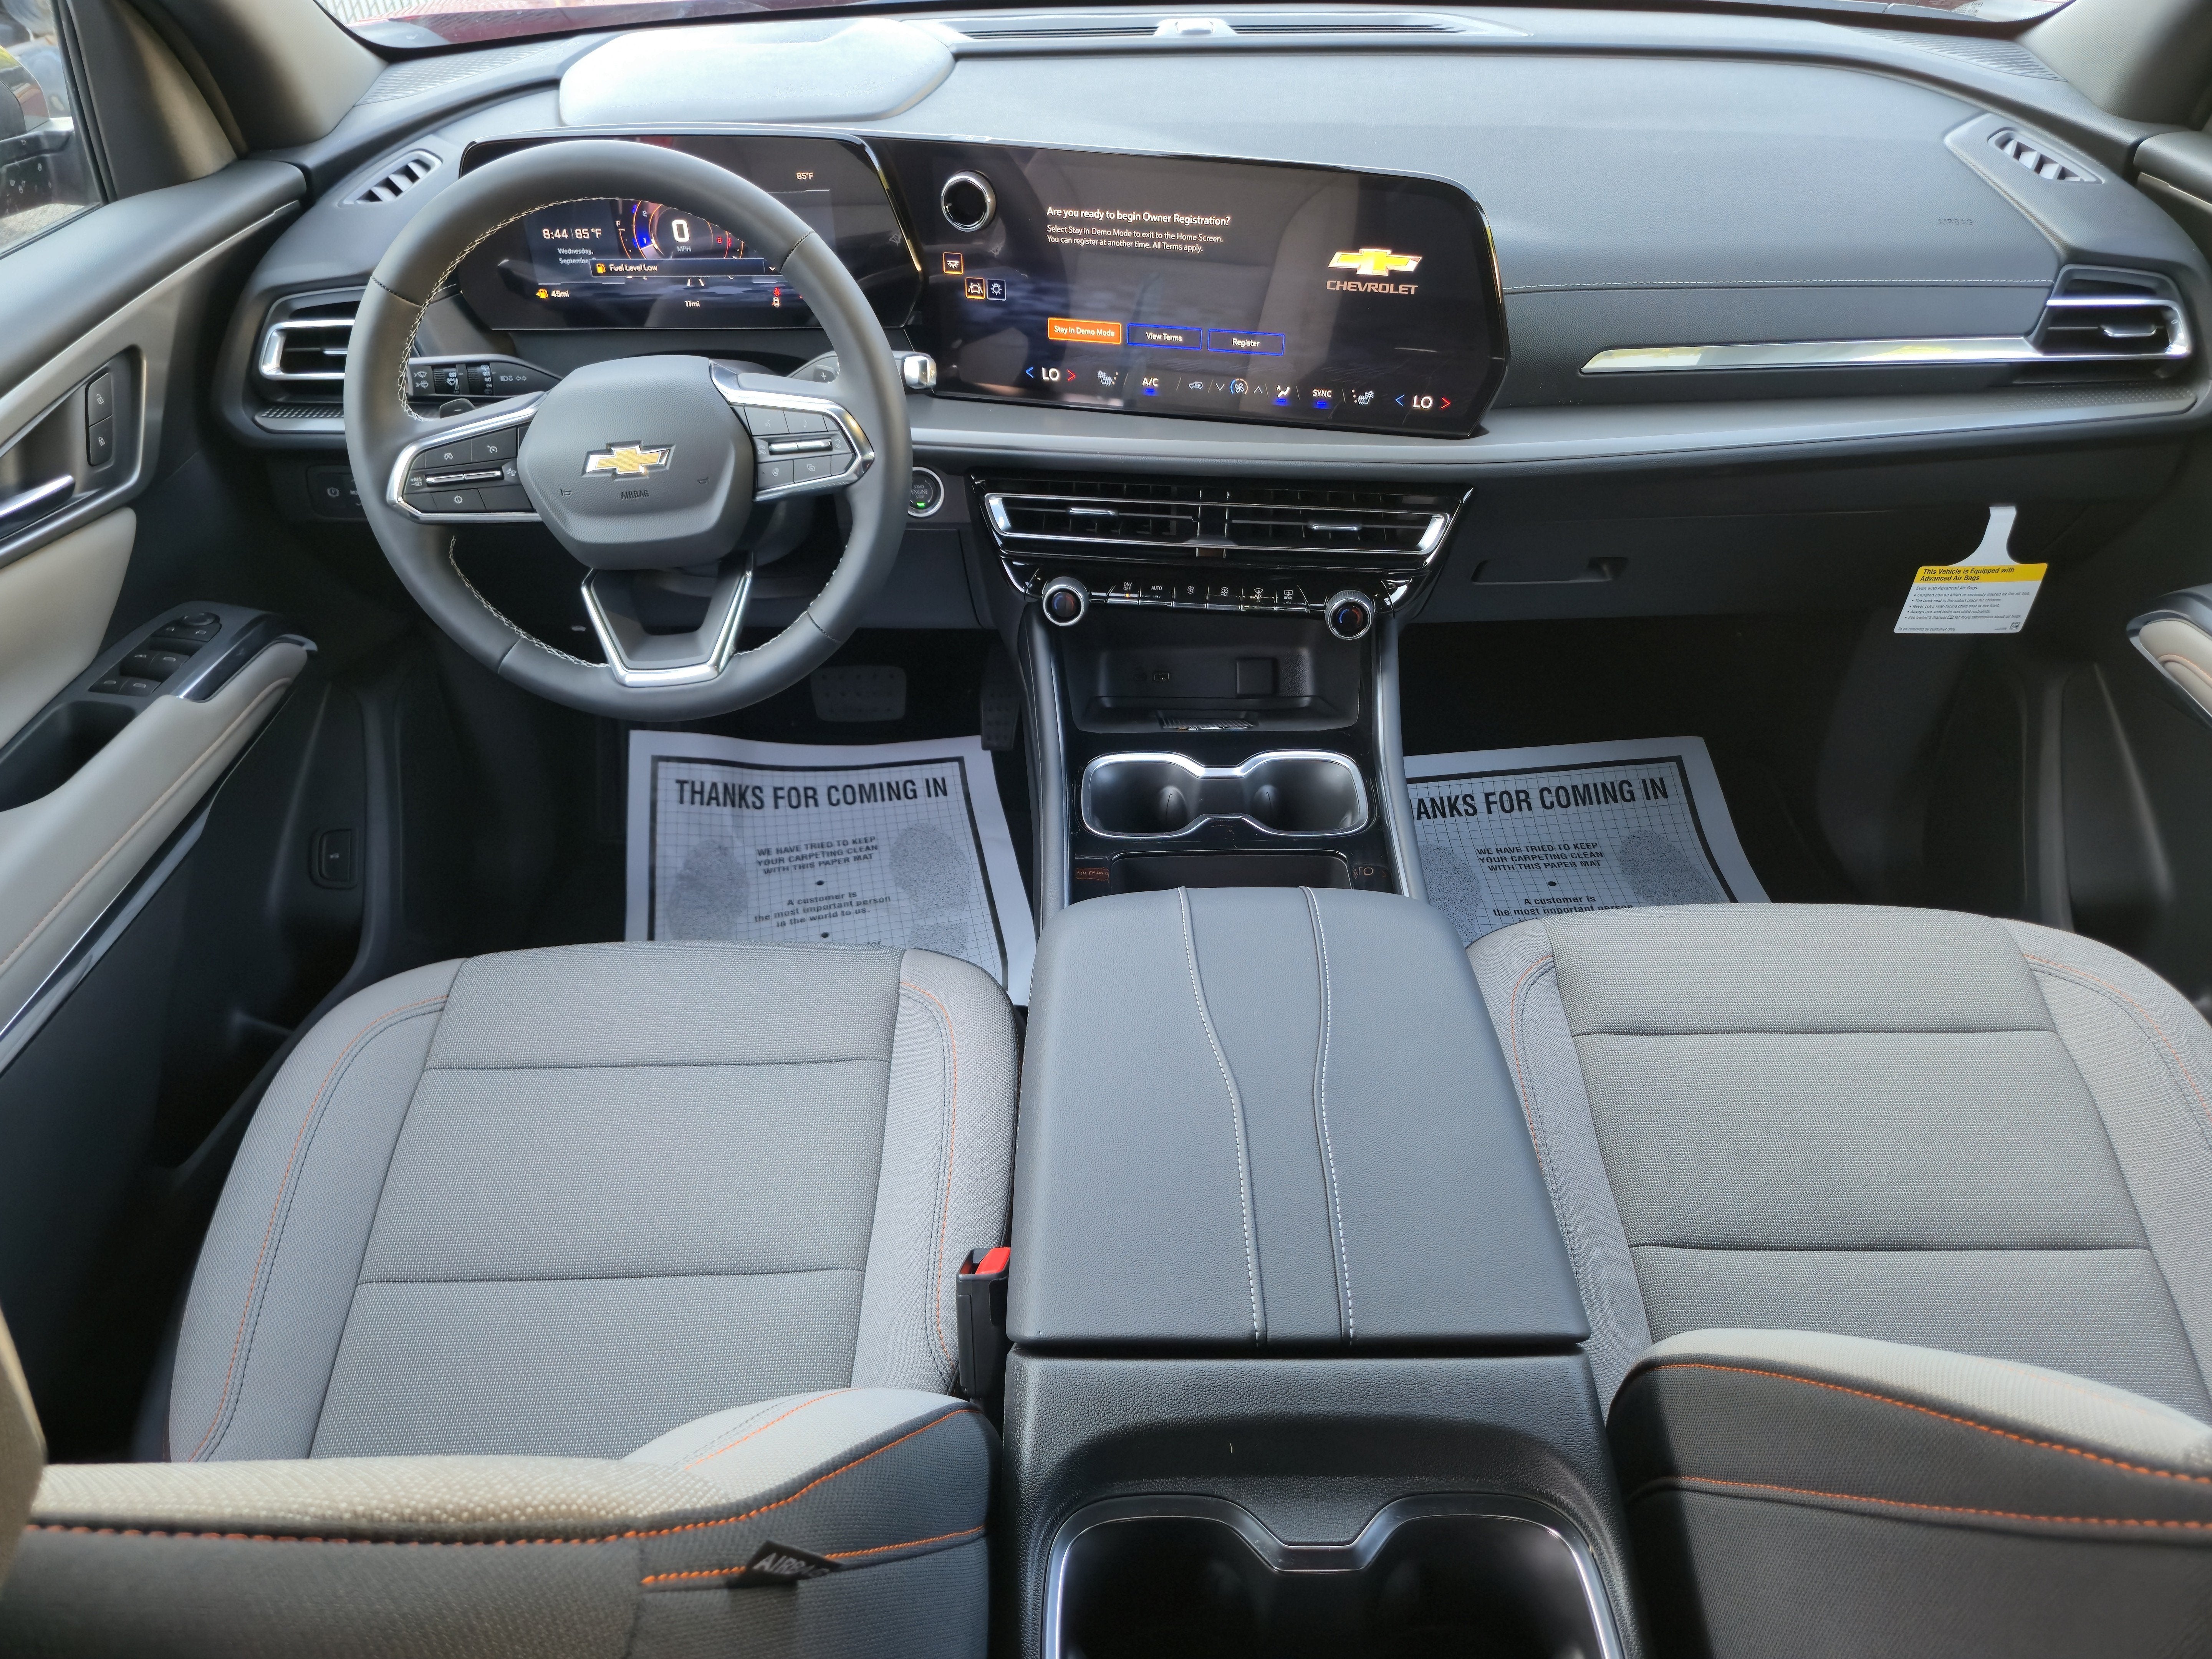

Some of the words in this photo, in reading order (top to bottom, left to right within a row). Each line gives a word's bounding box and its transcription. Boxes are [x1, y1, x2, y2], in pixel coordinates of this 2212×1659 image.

[1047, 207, 1062, 216] Are
[1063, 210, 1078, 219] you
[1080, 209, 1104, 221] ready
[1106, 210, 1115, 219] to
[1117, 210, 1141, 222] begin
[1142, 212, 1172, 222] Owner
[1174, 214, 1230, 226] Registration?
[542, 228, 569, 240] 8:44
[575, 228, 590, 239] 85
[672, 220, 690, 242] 0
[1047, 225, 1067, 233] Select
[1068, 226, 1083, 236] Stay
[1091, 227, 1111, 236] Demo
[1113, 229, 1132, 237] Mode
[1177, 233, 1197, 241] Home
[1198, 234, 1223, 242] Screen.
[1074, 238, 1099, 246] register
[1162, 242, 1182, 250] Terms
[1184, 244, 1203, 253] apply.
[559, 257, 590, 265] Septembe
[1326, 280, 1418, 295] CHEVROLET
[1054, 325, 1068, 334] Stay
[1076, 327, 1095, 335] Demo
[1096, 328, 1115, 336] Mode
[1146, 332, 1162, 340] View
[1162, 333, 1182, 342] Terms
[1232, 338, 1260, 348] Register
[1042, 367, 1060, 381] LO
[1142, 377, 1159, 386] A/C
[1312, 389, 1332, 398] SYNC
[1413, 395, 1433, 409] LO
[675, 778, 765, 810] THANKS
[773, 786, 818, 810] FOR
[827, 778, 917, 806] COMING
[926, 777, 948, 797] IN
[1411, 794, 1477, 820] ANKS
[1485, 789, 1532, 815] FOR
[1540, 780, 1636, 810] COMING
[1643, 777, 1668, 800] IN
[757, 848, 772, 856] WE
[776, 845, 802, 854] HAVE
[804, 841, 833, 850] TRIED
[851, 836, 876, 845] KEEP
[1496, 846, 1522, 854] HAVE
[757, 856, 785, 866] YOUR
[788, 849, 844, 863] CARPETING
[847, 845, 878, 854] CLEAN
[1510, 853, 1568, 862] CARPETING
[763, 866, 790, 874] WITH
[793, 862, 815, 870] THIS
[818, 857, 850, 867] PAPER
[853, 853, 874, 861] MAT
[797, 894, 845, 904] customer
[1534, 896, 1583, 905] customer
[754, 914, 770, 922] the
[774, 908, 799, 918] most
[803, 900, 853, 913] important
[856, 896, 891, 907] person
[1514, 907, 1540, 915] most
[1543, 905, 1594, 914] important
[790, 916, 806, 925] the
[809, 911, 838, 921] world
